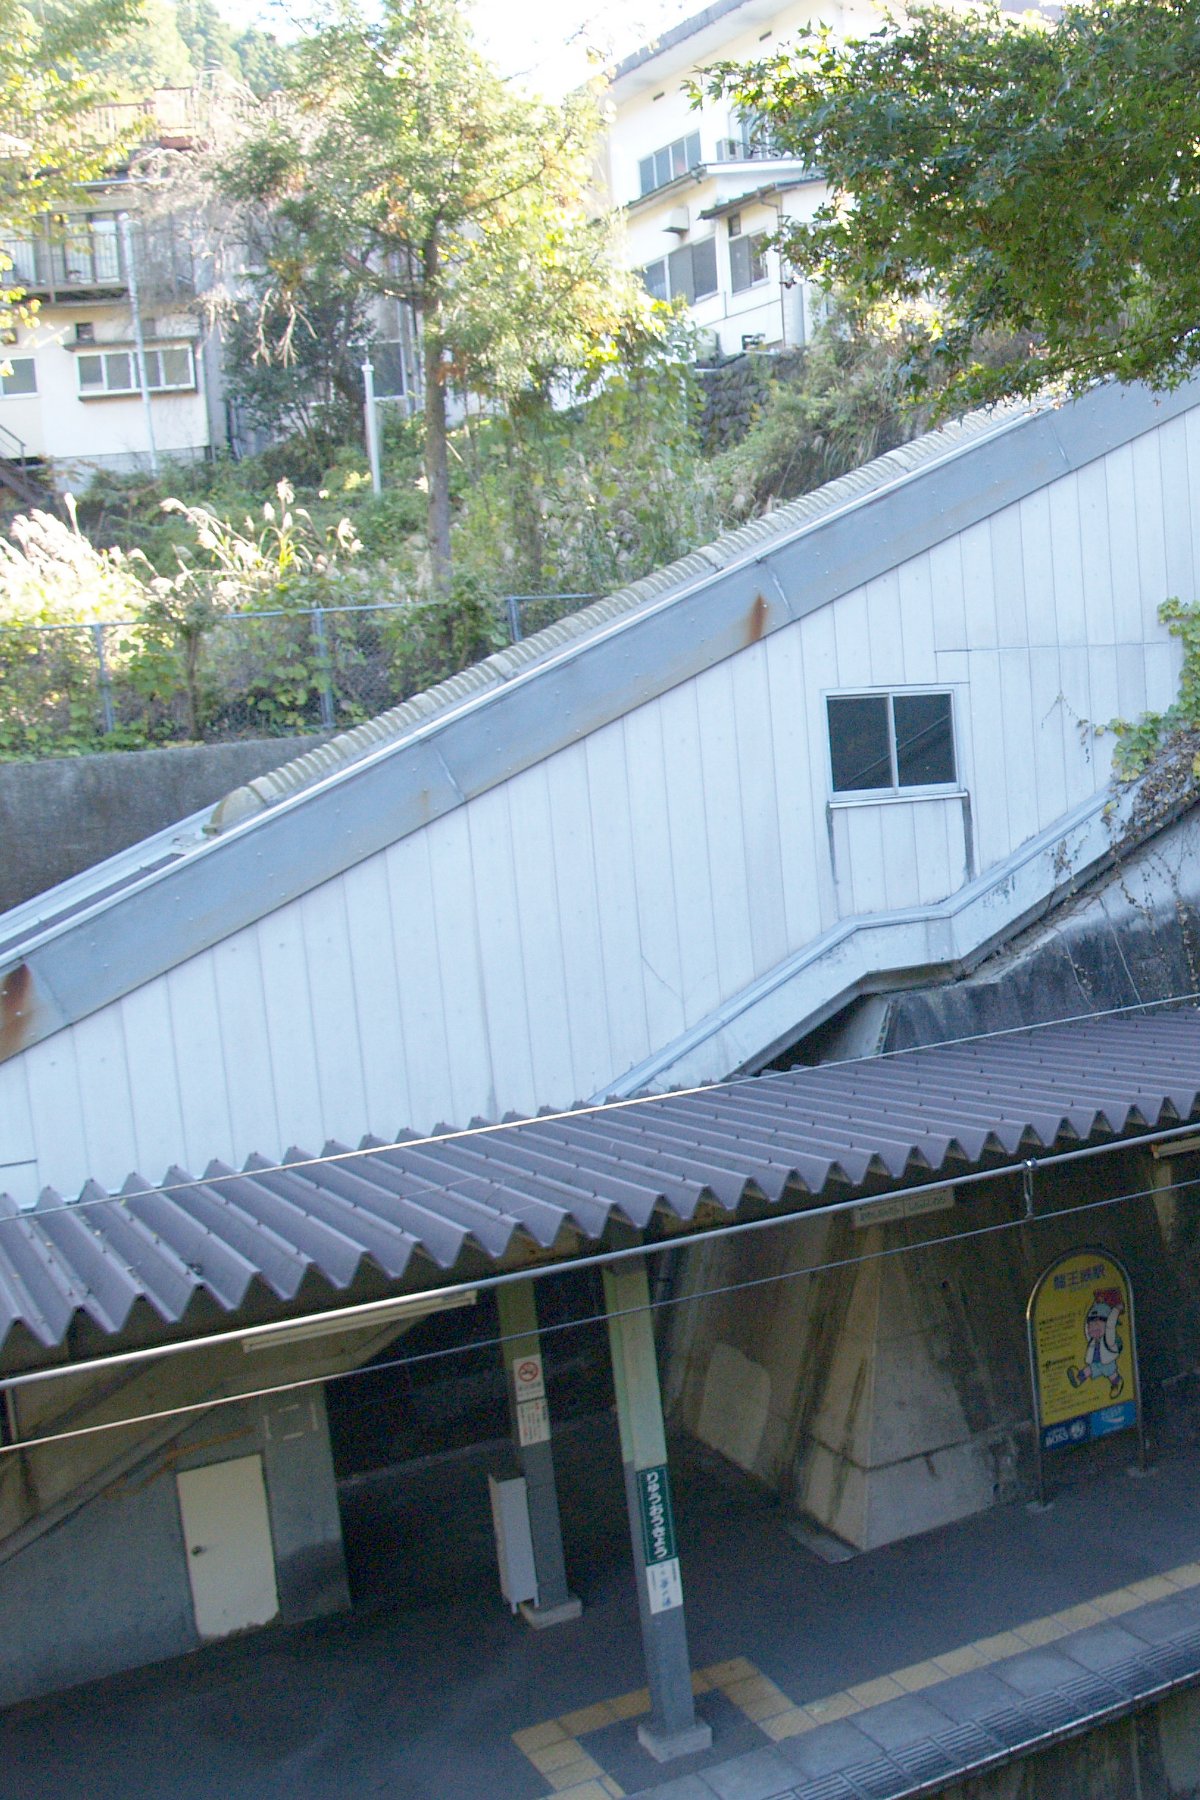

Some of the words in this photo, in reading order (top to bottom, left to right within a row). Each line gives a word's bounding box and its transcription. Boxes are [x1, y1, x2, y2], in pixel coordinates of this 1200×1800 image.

[646, 1472, 667, 1559] りゅうおうきょう
